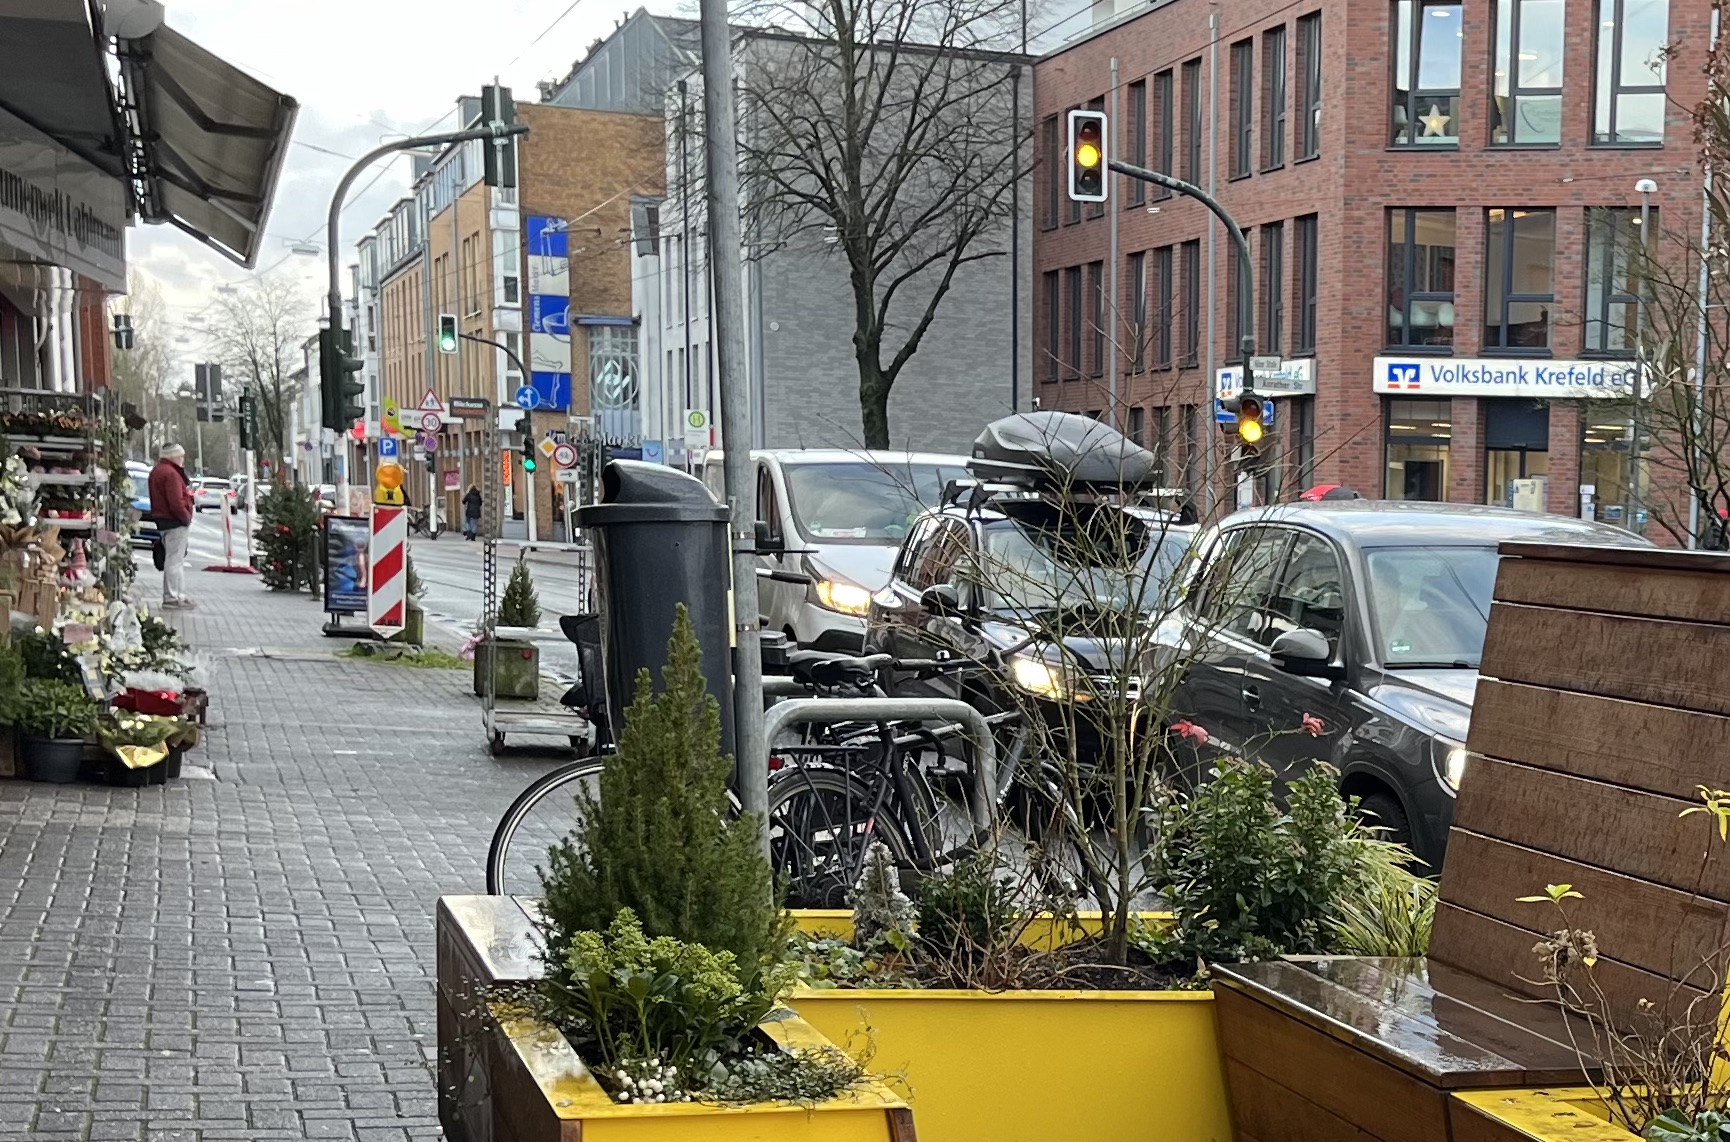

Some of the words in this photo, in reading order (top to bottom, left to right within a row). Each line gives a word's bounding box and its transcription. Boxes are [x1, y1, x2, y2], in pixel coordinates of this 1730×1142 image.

[1431, 364, 1529, 385] Volksbank
[1535, 366, 1605, 387] Krefeld
[1611, 368, 1637, 387] eG
[425, 417, 437, 428] 30
[383, 439, 394, 454] P
